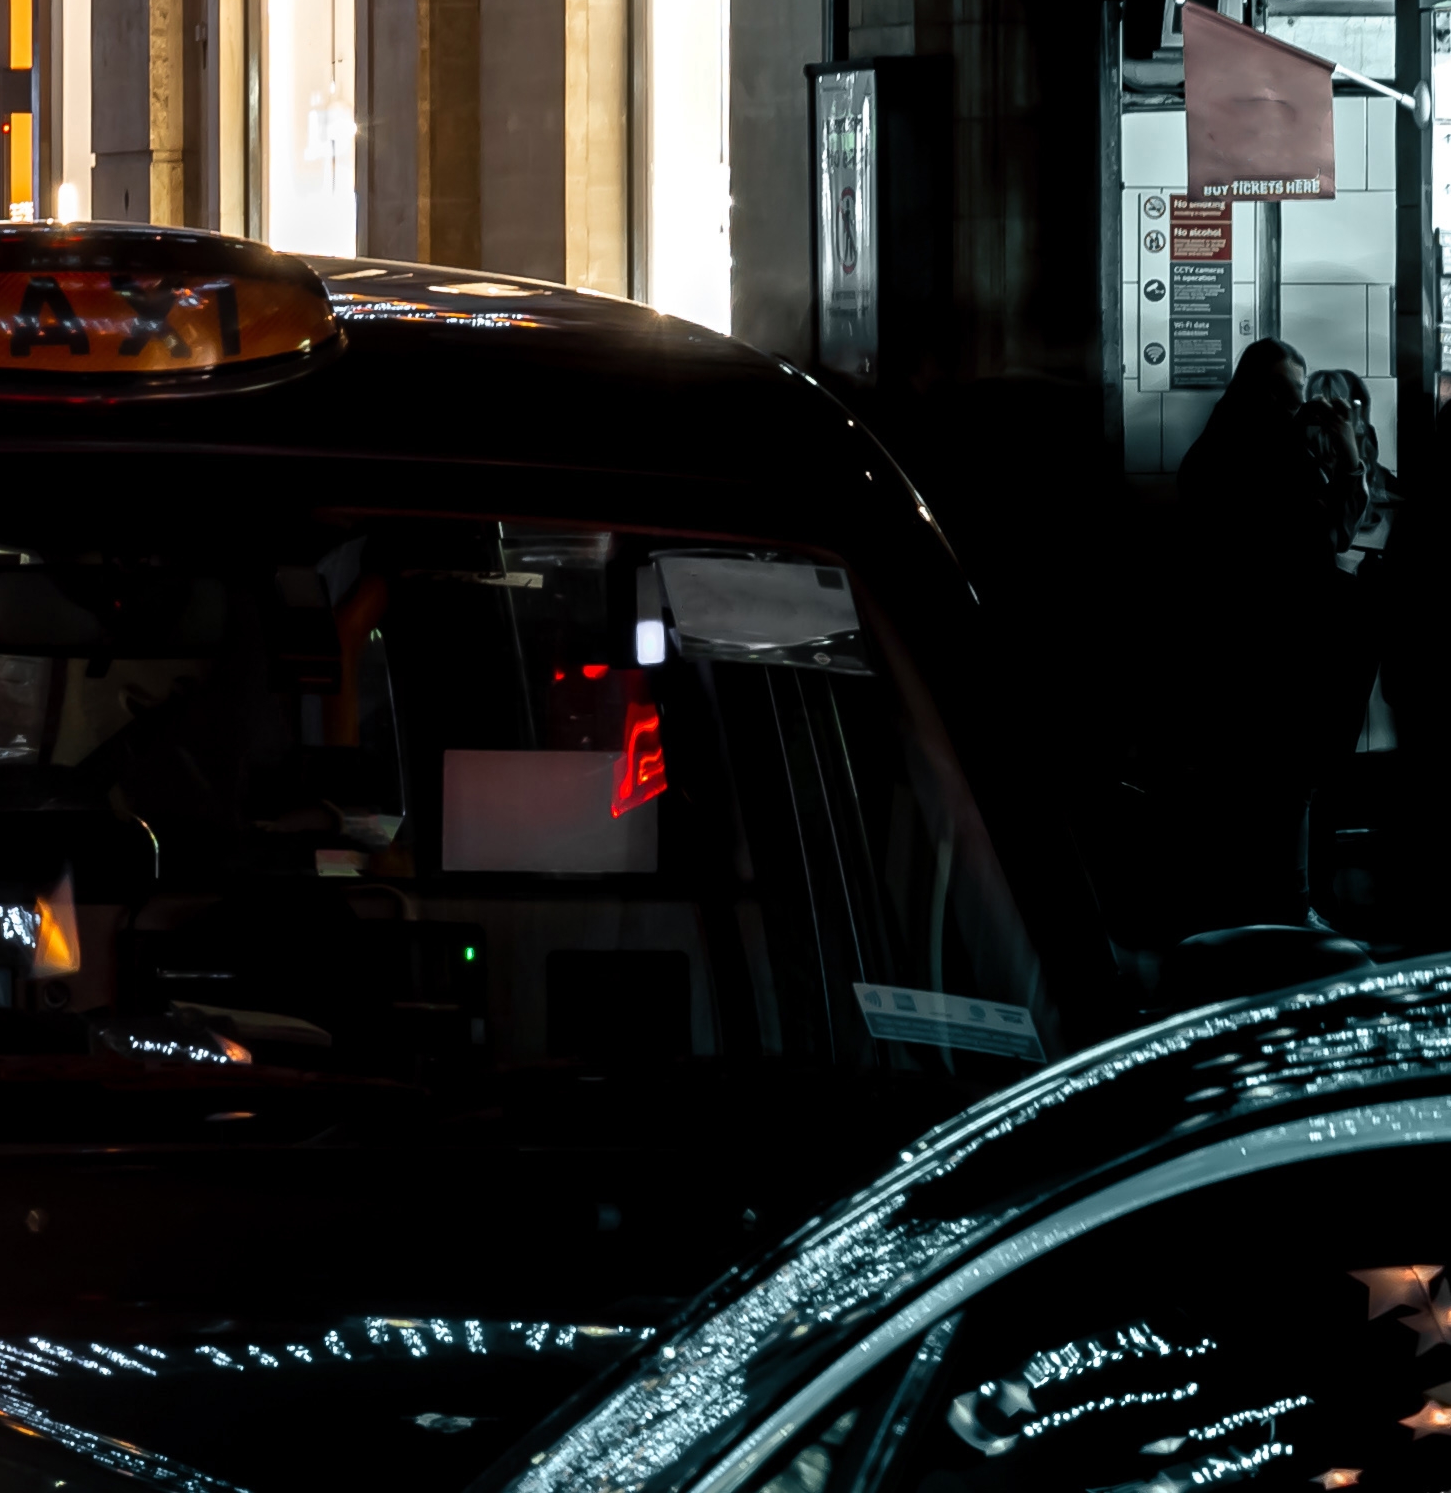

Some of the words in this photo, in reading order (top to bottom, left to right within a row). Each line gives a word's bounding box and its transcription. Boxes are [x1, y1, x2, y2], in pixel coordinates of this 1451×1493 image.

[1203, 184, 1229, 197] BUY
[1231, 179, 1284, 196] TICKETS
[1285, 179, 1321, 194] HERE
[1174, 199, 1188, 209] No
[1174, 227, 1188, 237] No
[1189, 227, 1222, 237] alcohol
[1174, 266, 1194, 274] CCTV
[1195, 266, 1225, 275] cameras
